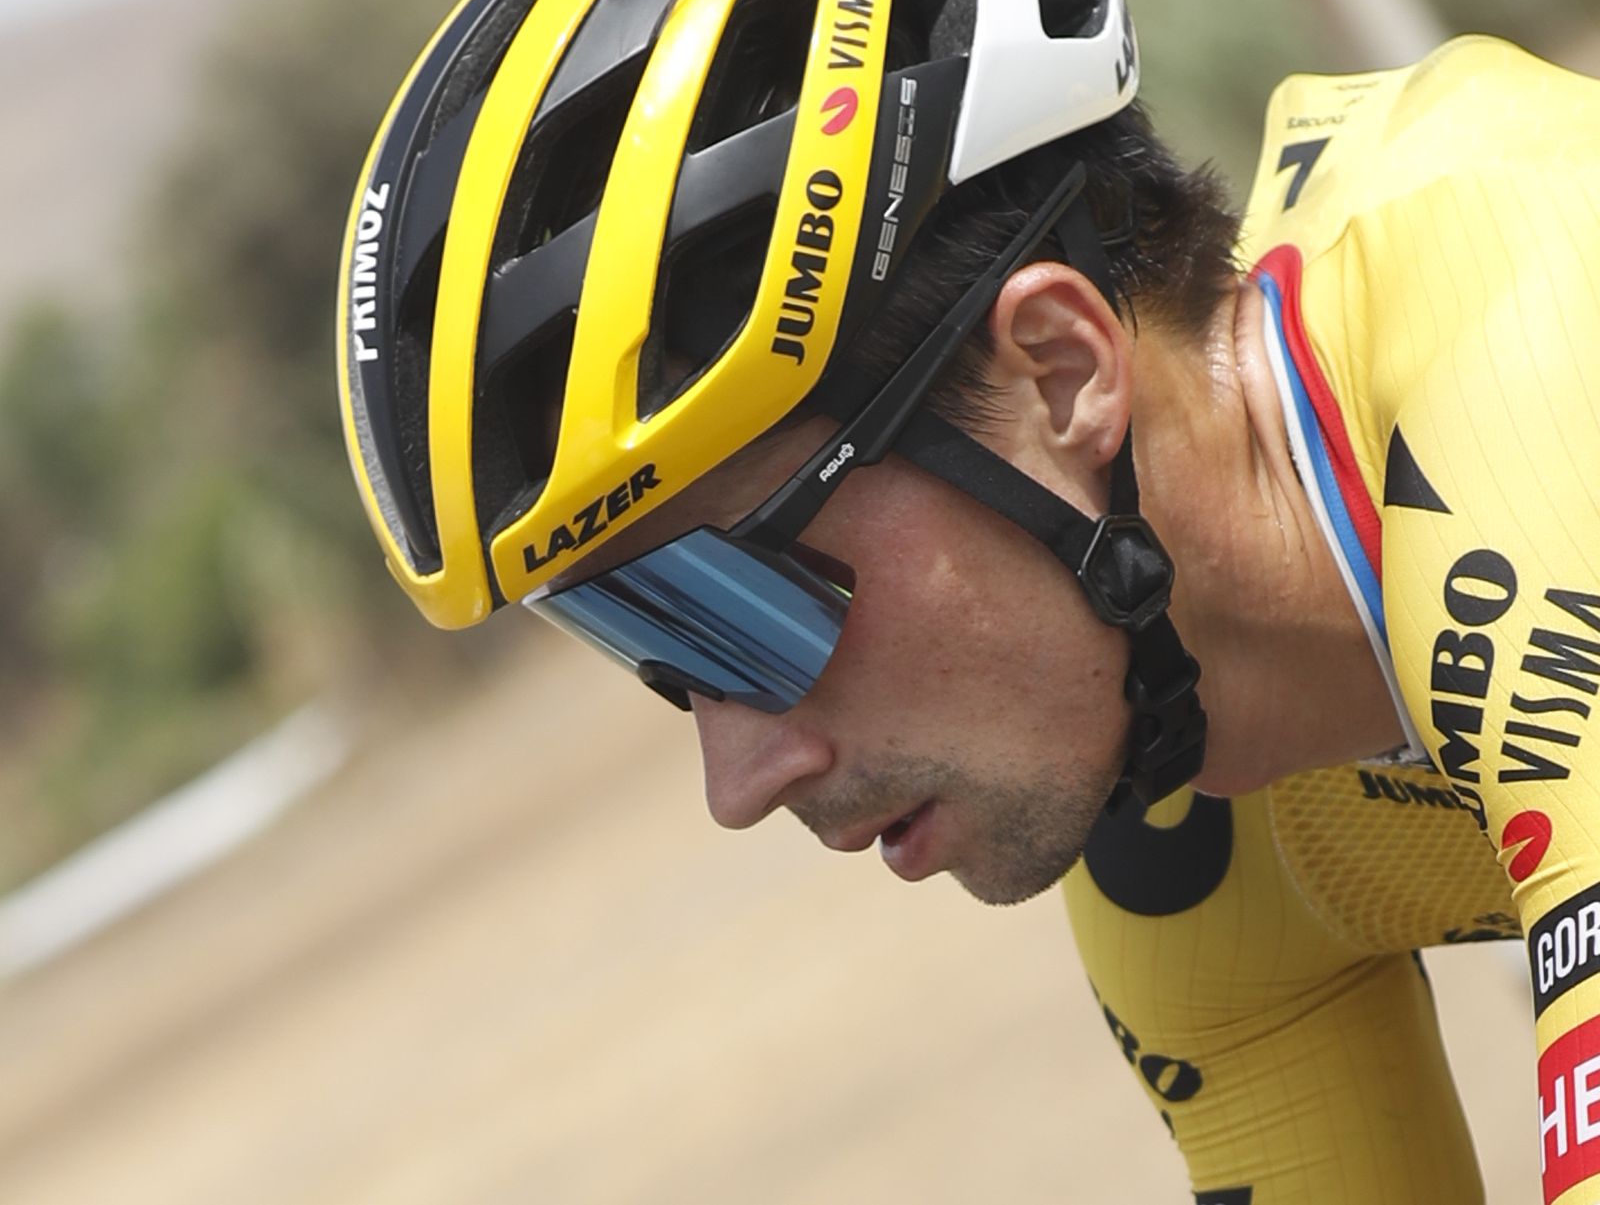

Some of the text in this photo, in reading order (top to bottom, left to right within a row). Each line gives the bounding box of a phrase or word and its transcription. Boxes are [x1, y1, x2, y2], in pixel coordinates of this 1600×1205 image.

[771, 169, 843, 366] JUMBO
[871, 77, 917, 281] GENESIS
[523, 463, 662, 573] LAZER
[1431, 549, 1517, 836] UMBO
